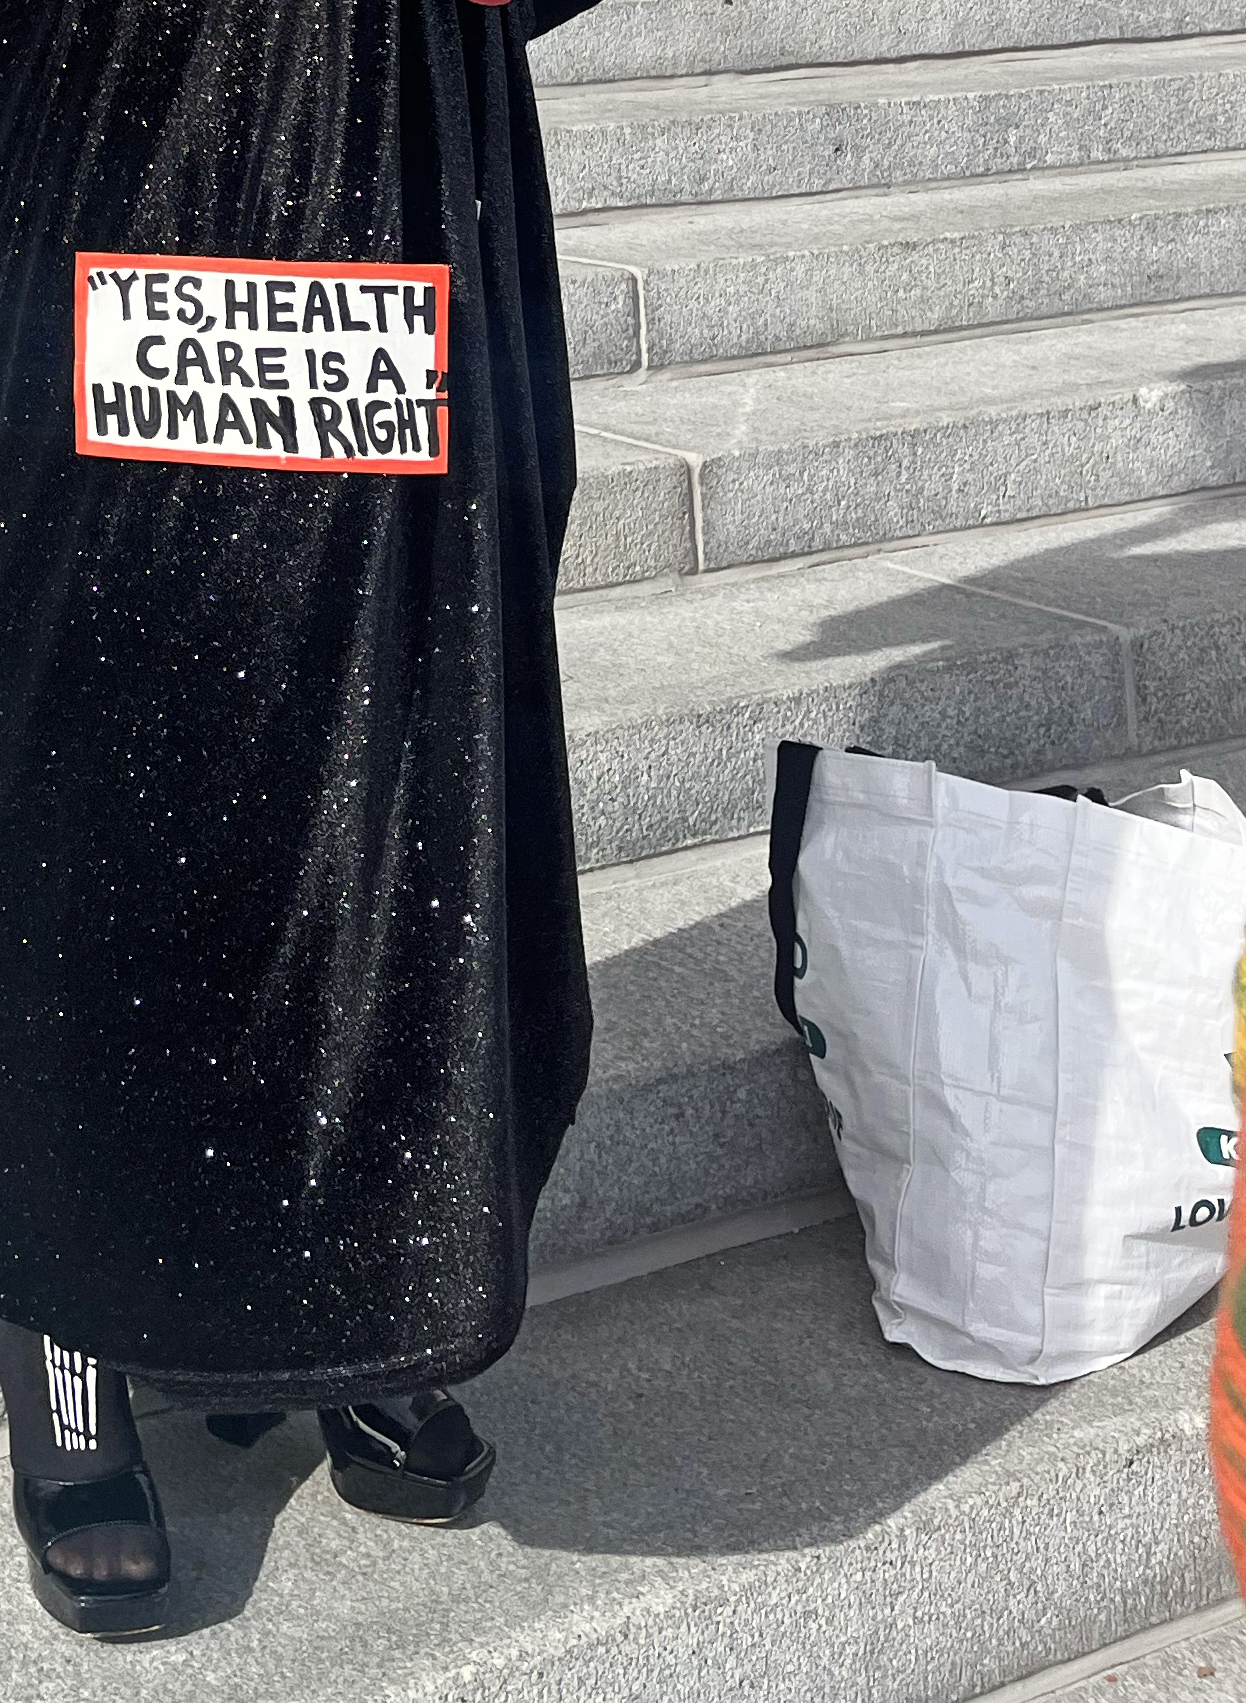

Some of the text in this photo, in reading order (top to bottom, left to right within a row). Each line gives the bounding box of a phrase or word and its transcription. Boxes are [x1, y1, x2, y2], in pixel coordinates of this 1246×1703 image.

[225, 279, 437, 335] HEALTH
[136, 335, 406, 394] CARE IS A
[92, 383, 299, 454] HUMAN
[1171, 1198, 1231, 1232] LOV
